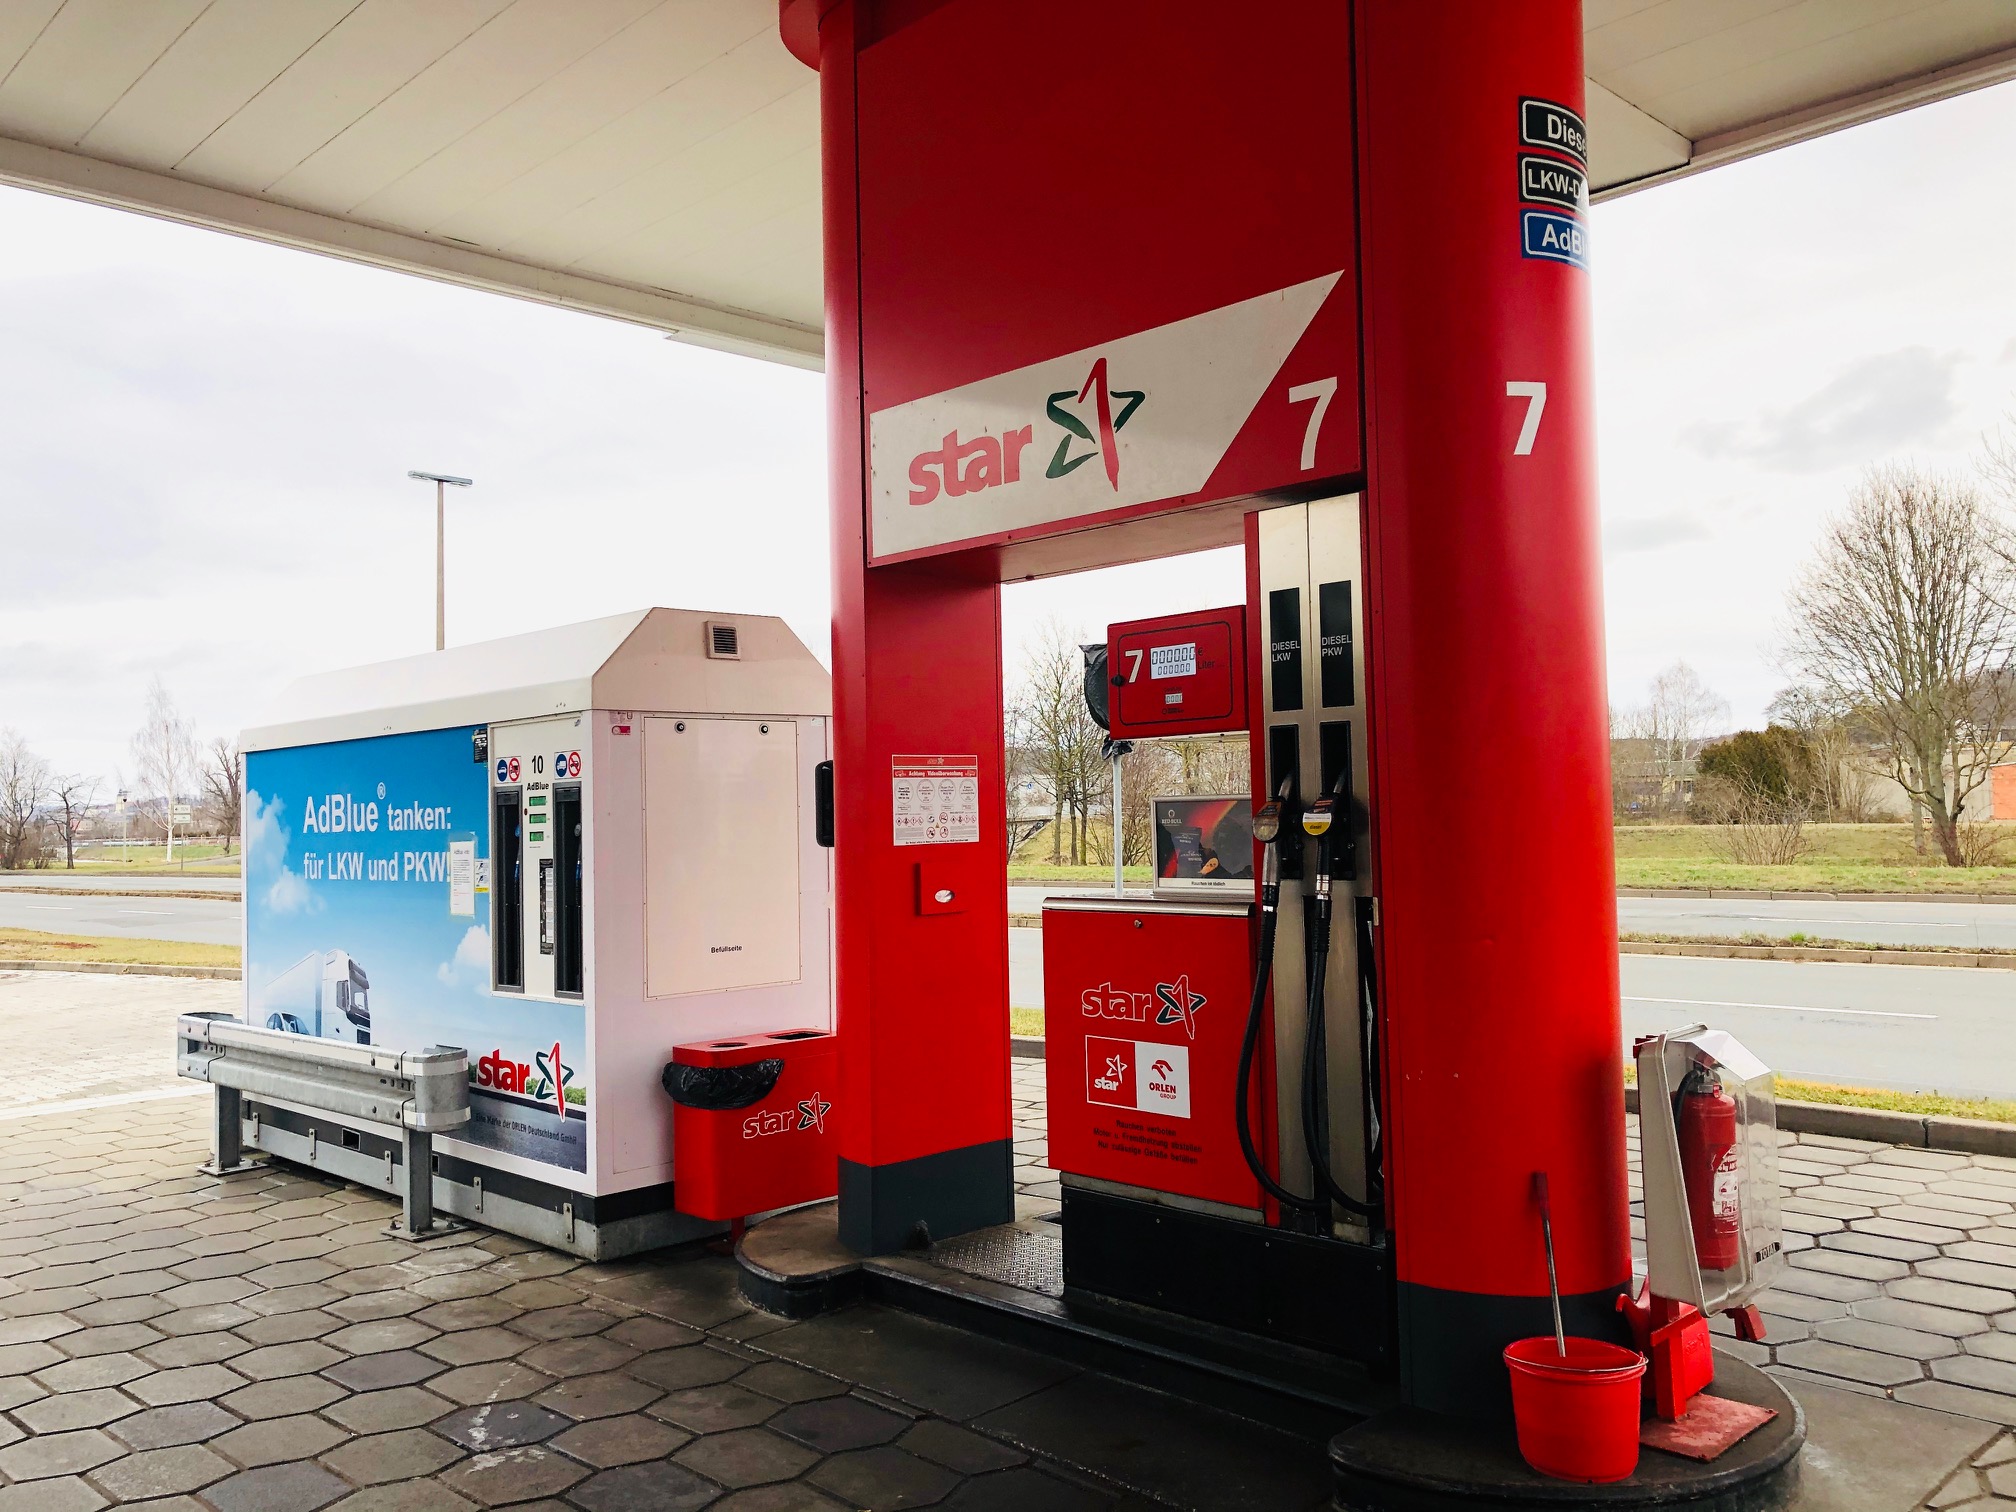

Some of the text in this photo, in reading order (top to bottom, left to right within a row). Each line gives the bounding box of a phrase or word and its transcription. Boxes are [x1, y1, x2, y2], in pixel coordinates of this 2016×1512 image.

[1547, 113, 1588, 158] Diese
[1288, 376, 1338, 471] 7
[1506, 381, 1547, 454] 7
[908, 424, 1033, 506] star
[1272, 640, 1301, 652] DIESEL
[1321, 635, 1352, 646] DIESEL
[1322, 647, 1343, 657] PKW
[1125, 649, 1143, 683] 7
[1272, 652, 1291, 662] LKW
[531, 754, 544, 774] 10
[526, 782, 550, 791] AdBlue
[387, 800, 452, 832] tanken:
[303, 852, 324, 880] für
[328, 852, 364, 881] LKW
[368, 851, 399, 881] und
[1081, 981, 1152, 1022] star
[477, 1048, 531, 1095] star
[1094, 1077, 1119, 1091] star
[1148, 1082, 1177, 1094] ORLEN
[502, 1119, 511, 1129] der
[512, 1121, 527, 1132] ORLEN
[528, 1125, 559, 1141] Deutschland
[561, 1133, 577, 1145] GmbH
[742, 1110, 795, 1139] star
